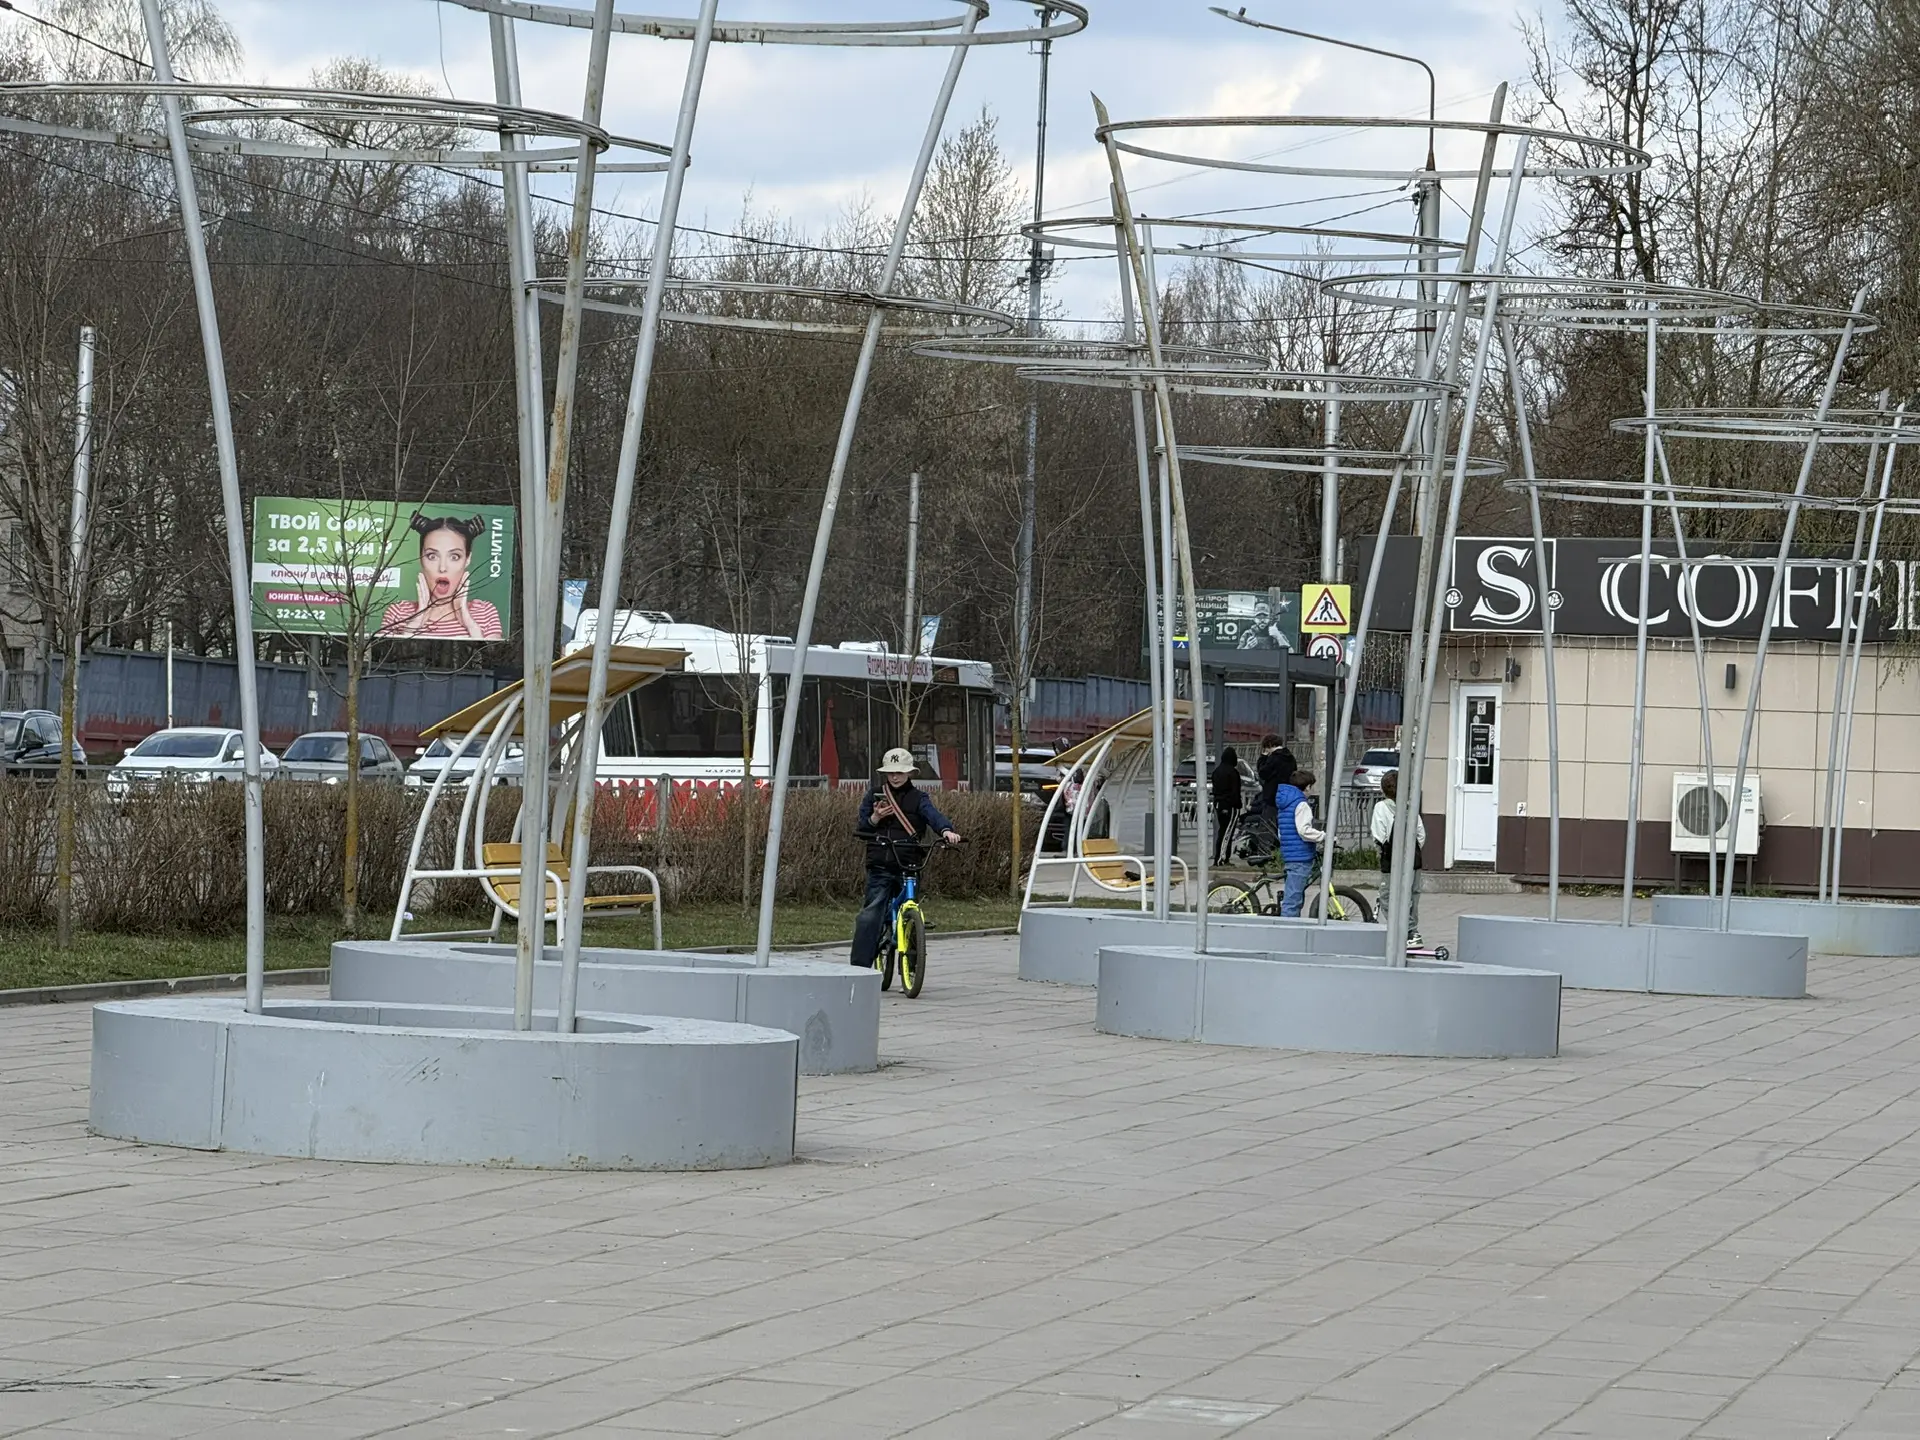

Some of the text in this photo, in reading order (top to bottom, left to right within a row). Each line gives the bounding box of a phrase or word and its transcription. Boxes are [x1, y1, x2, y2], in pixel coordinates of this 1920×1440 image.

[268, 511, 385, 533] ТВОЙ ОФИС
[266, 538, 290, 552] за
[297, 536, 328, 556] 2,5
[490, 518, 503, 578] ЮНИТИ
[1470, 545, 1535, 625] S
[276, 608, 326, 620] 32-22-22
[1216, 622, 1238, 635] 10
